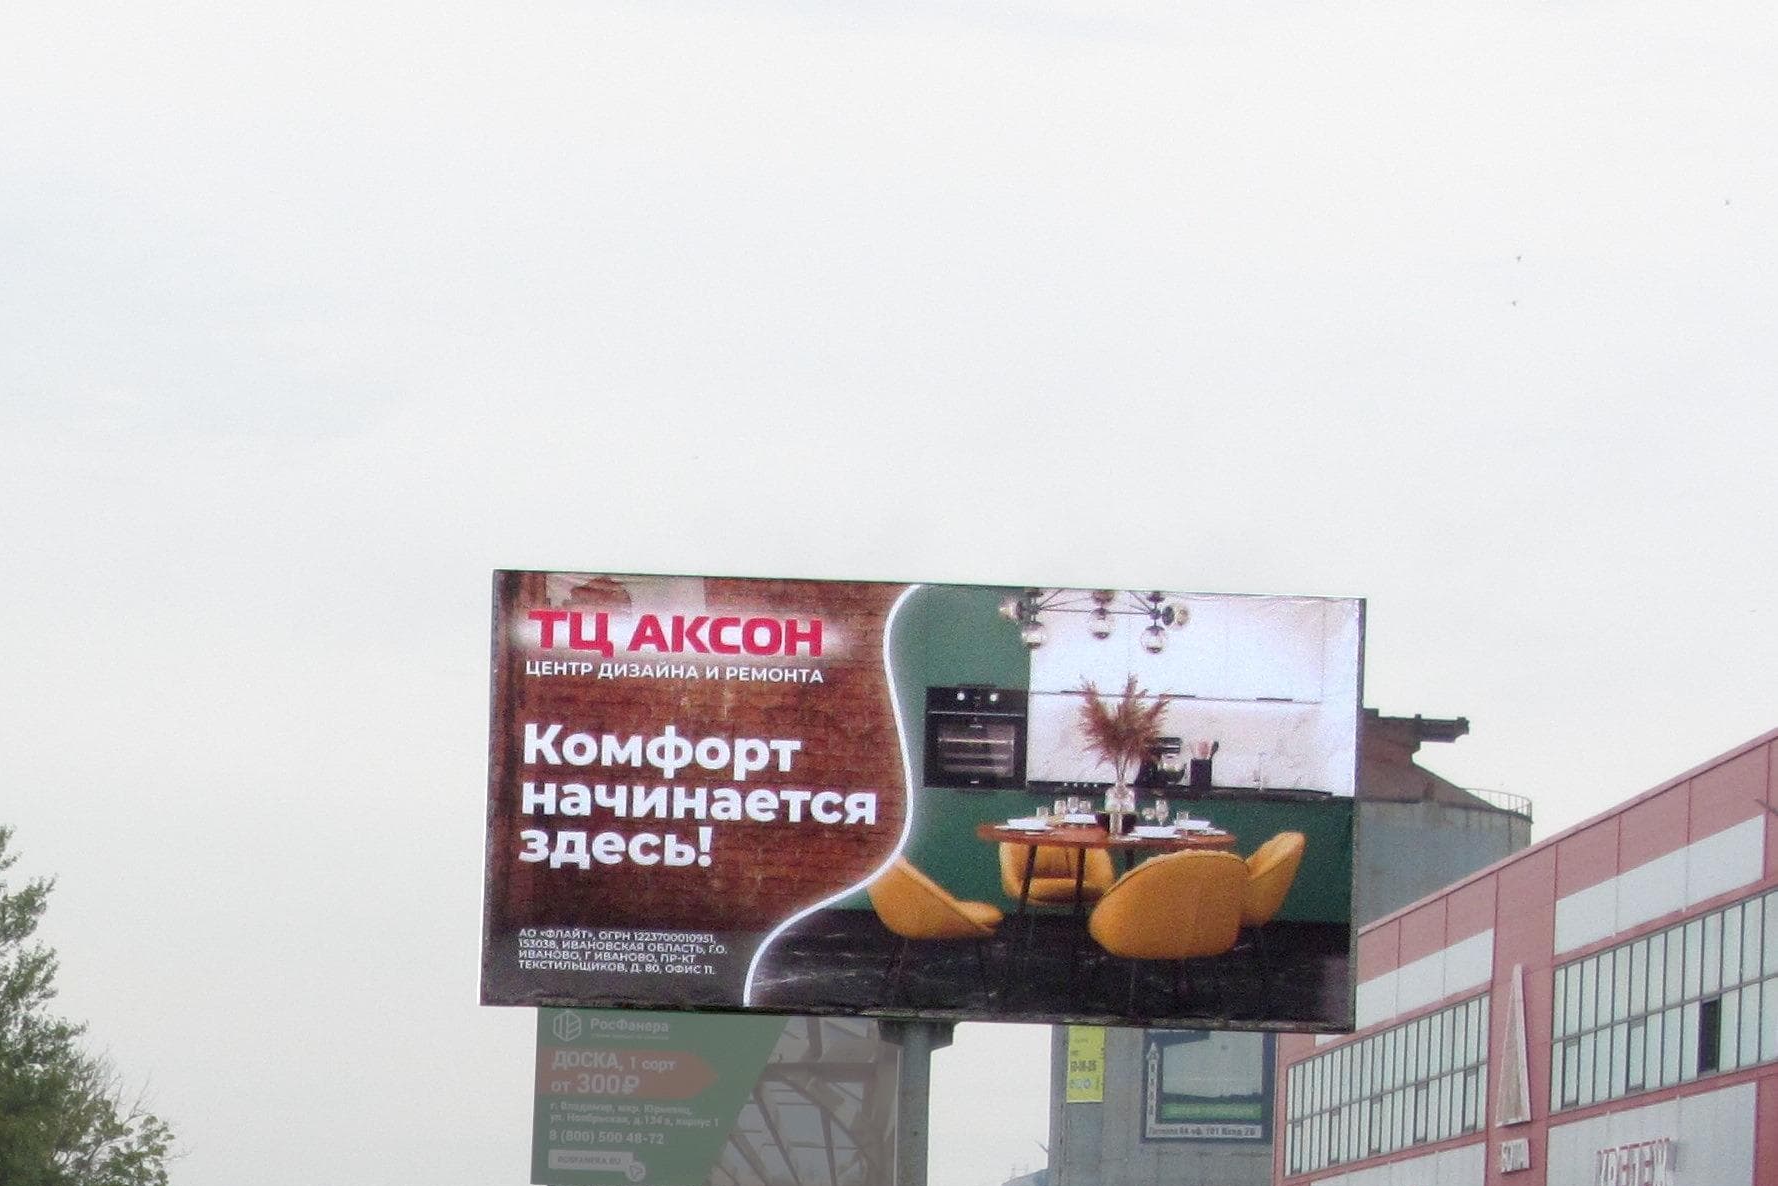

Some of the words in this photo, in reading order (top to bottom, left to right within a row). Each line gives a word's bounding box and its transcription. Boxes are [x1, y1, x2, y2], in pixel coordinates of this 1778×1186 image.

[528, 609, 614, 658] ТЦ
[628, 613, 823, 657] АКСОН
[525, 660, 593, 677] ЦЕНТР
[597, 660, 698, 680] ДИЗАЙНА
[705, 667, 719, 679] И
[725, 667, 824, 684] РЕМОНТА
[523, 722, 802, 781] Комфорт
[521, 782, 877, 825] начинается
[518, 826, 713, 870] здесь!
[518, 929, 537, 938] АО
[540, 928, 596, 941] «ФЛАЙТ»,
[599, 931, 631, 942] ОГРН
[518, 939, 559, 950] 153038,
[562, 940, 644, 952] ИВАНОВСКАЯ
[647, 943, 706, 955] ОБЛАСТЬ,
[518, 950, 582, 961] ИВАНОВО,
[594, 951, 658, 963] ИВАНОВО,
[660, 954, 696, 963] ПР-КТ
[518, 960, 628, 972] ТЕКСТИЛЬЩИКОВ,
[665, 965, 701, 974] ОФИС
[589, 1017, 669, 1034] РосФанера
[551, 1050, 624, 1073] ДОСКА,
[630, 1057, 637, 1069] 1
[641, 1058, 676, 1073] сорт
[550, 1079, 571, 1093] от
[549, 1129, 558, 1142] 8
[560, 1129, 595, 1145] (800)
[598, 1131, 623, 1143] 500
[625, 1132, 665, 1145] 48-72
